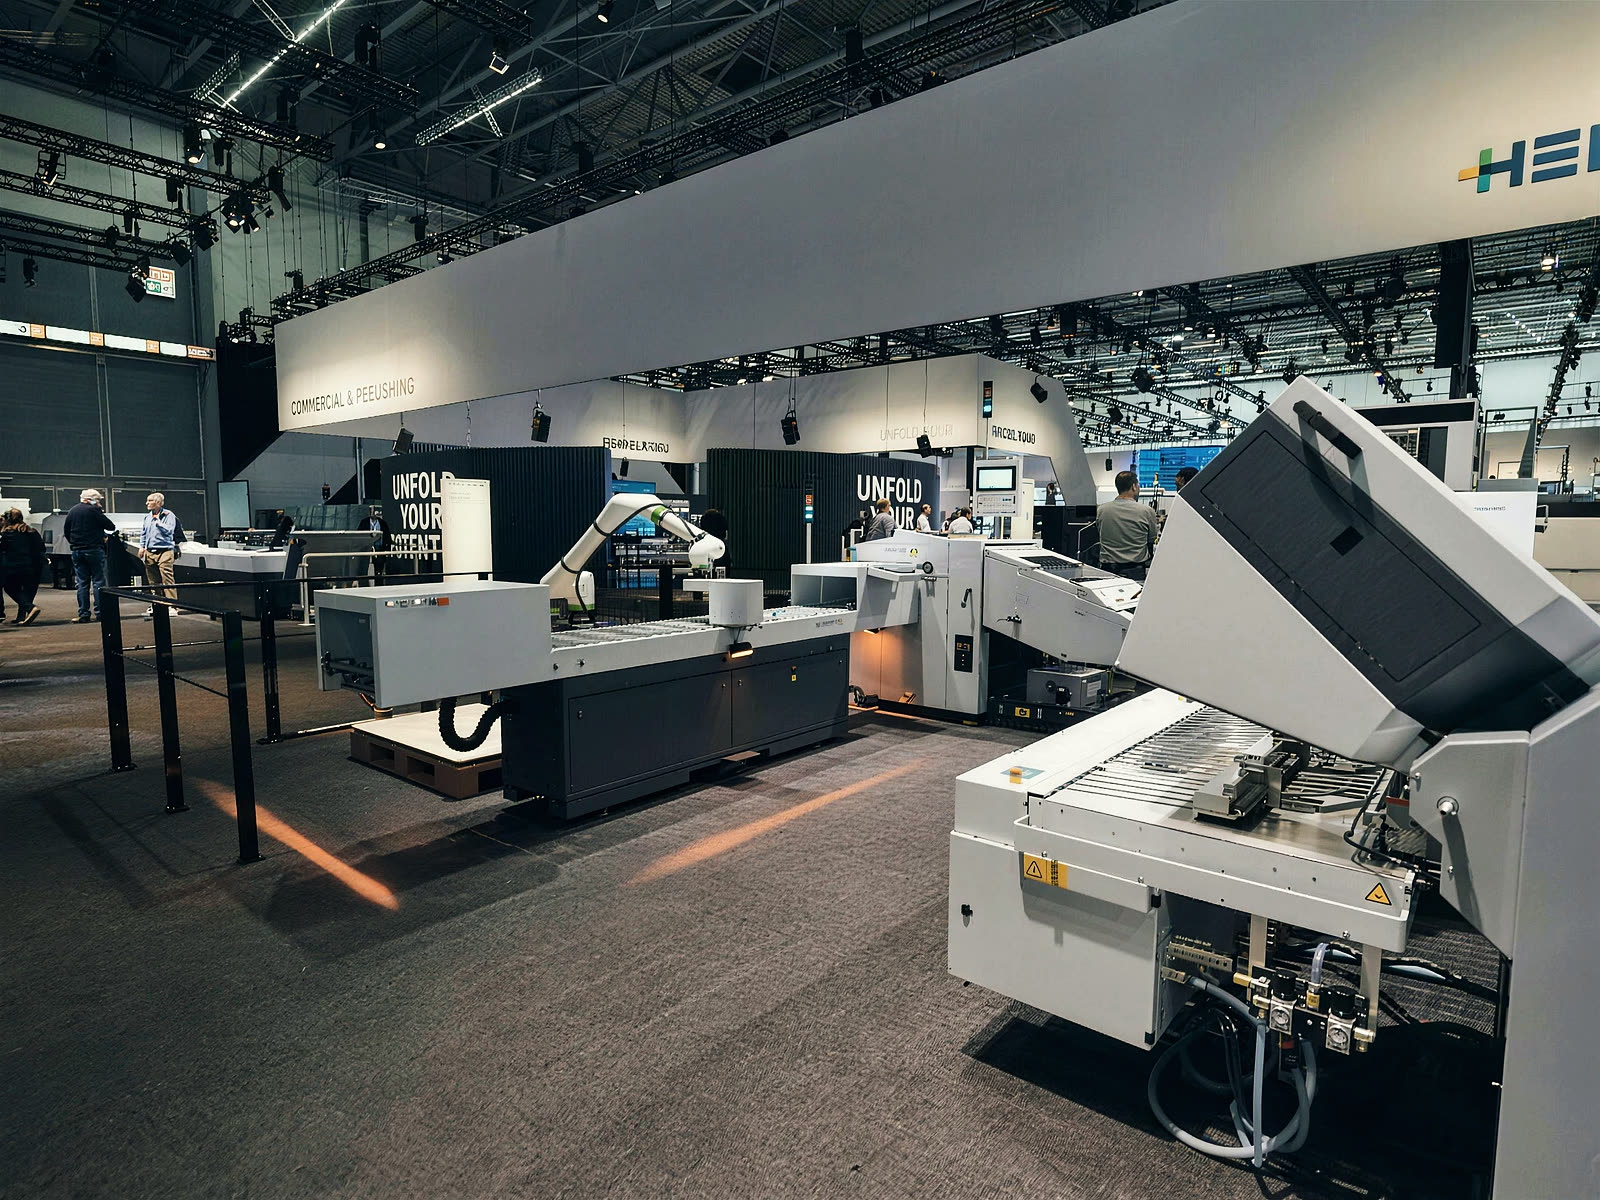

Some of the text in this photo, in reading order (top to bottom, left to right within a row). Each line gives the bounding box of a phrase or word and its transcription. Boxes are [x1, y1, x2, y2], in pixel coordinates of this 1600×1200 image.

[291, 392, 344, 415] COMMERCIAL
[347, 390, 353, 406] &
[392, 471, 456, 500] UNFOL
[857, 474, 922, 503] UNFOLD
[400, 503, 442, 530] YOUR
